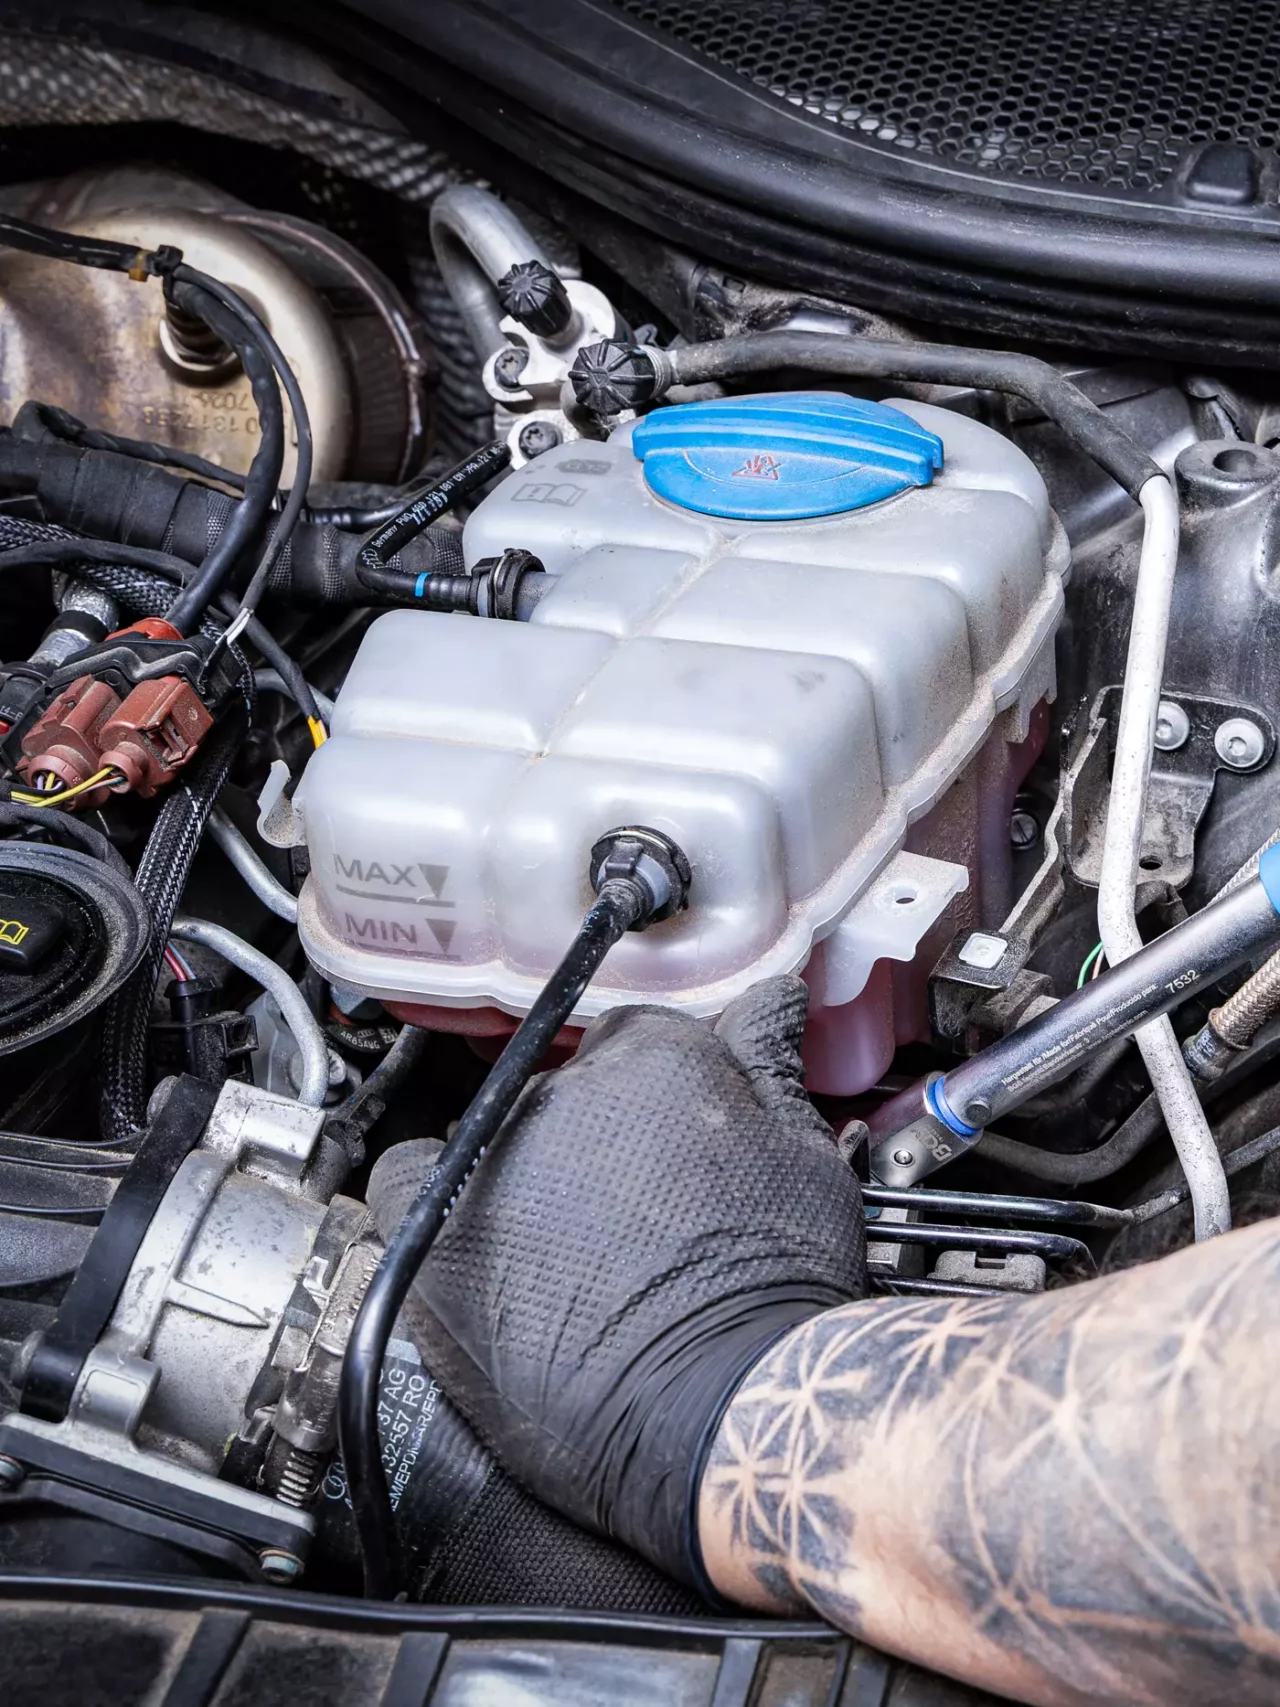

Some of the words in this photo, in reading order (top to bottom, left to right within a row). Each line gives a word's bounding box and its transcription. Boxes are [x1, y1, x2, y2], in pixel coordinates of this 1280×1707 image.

[333, 853, 417, 888] MAX
[344, 912, 418, 944] MIN
[1164, 968, 1201, 994] 7532
[384, 1368, 406, 1401] AG
[402, 1374, 426, 1408] RO
